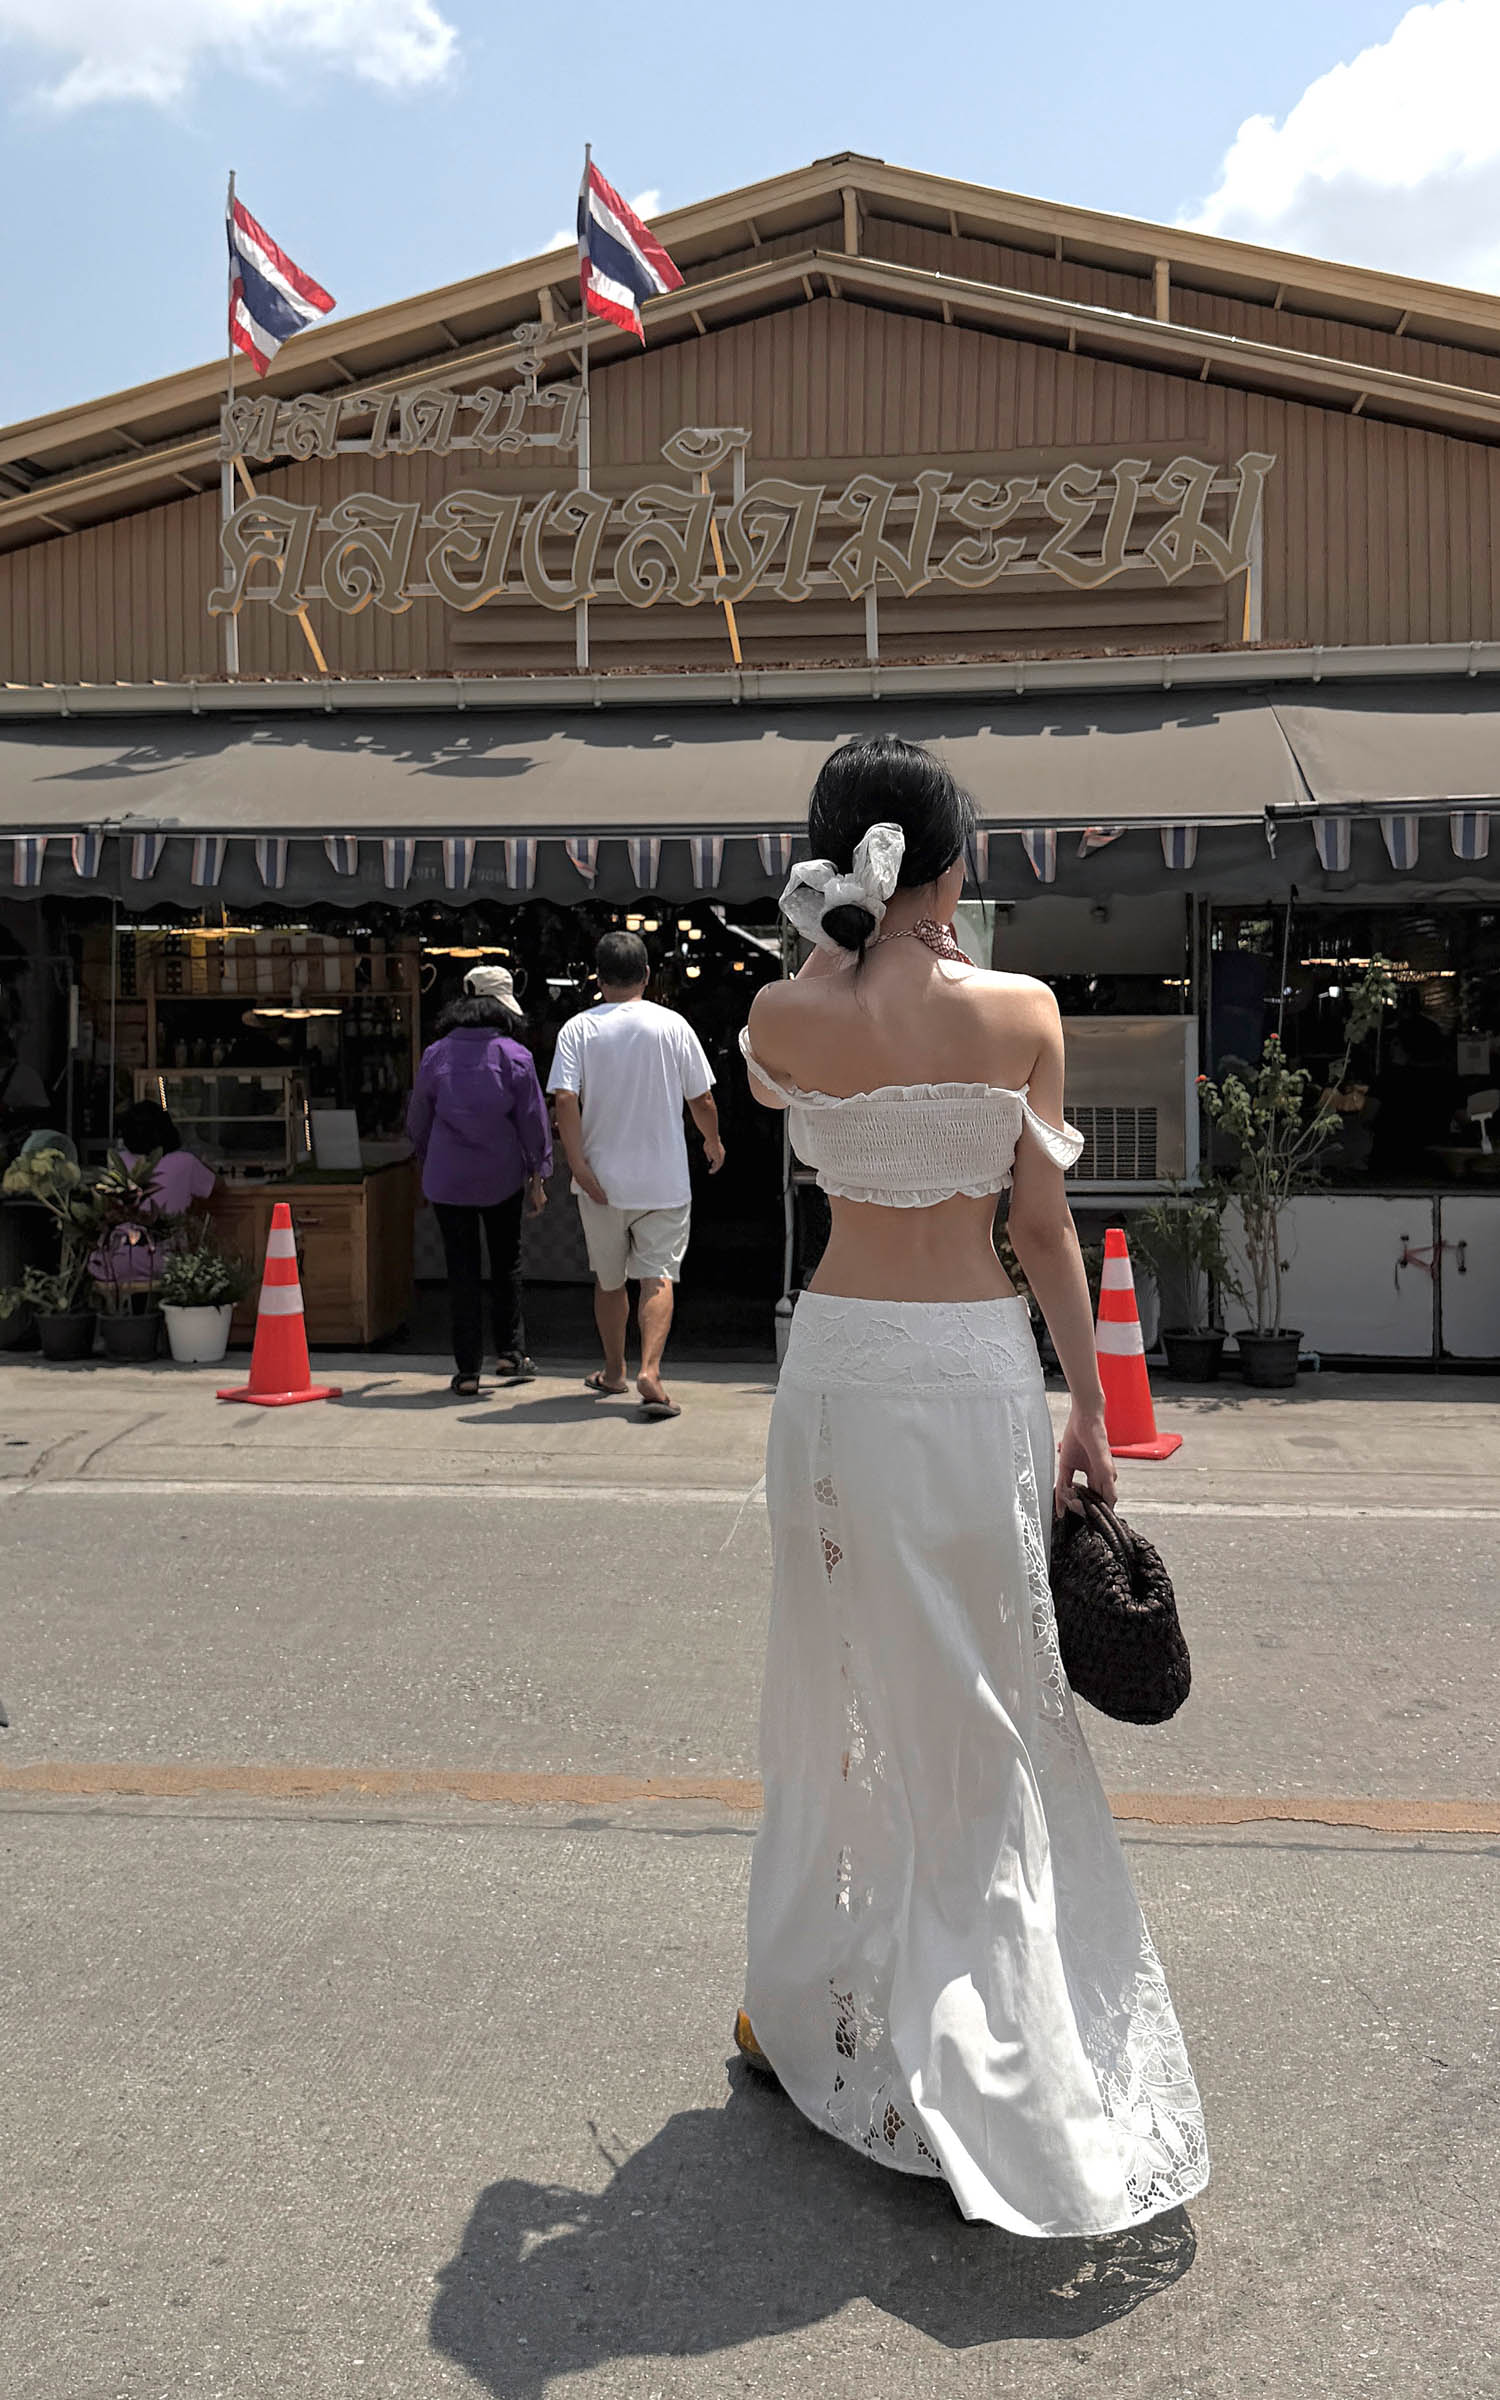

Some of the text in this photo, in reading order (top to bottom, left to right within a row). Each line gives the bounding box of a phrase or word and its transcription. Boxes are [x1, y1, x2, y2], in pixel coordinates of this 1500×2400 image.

[217, 322, 585, 463] ตลาดน้ำ
[208, 427, 1276, 615] คลองลัดมะยม
